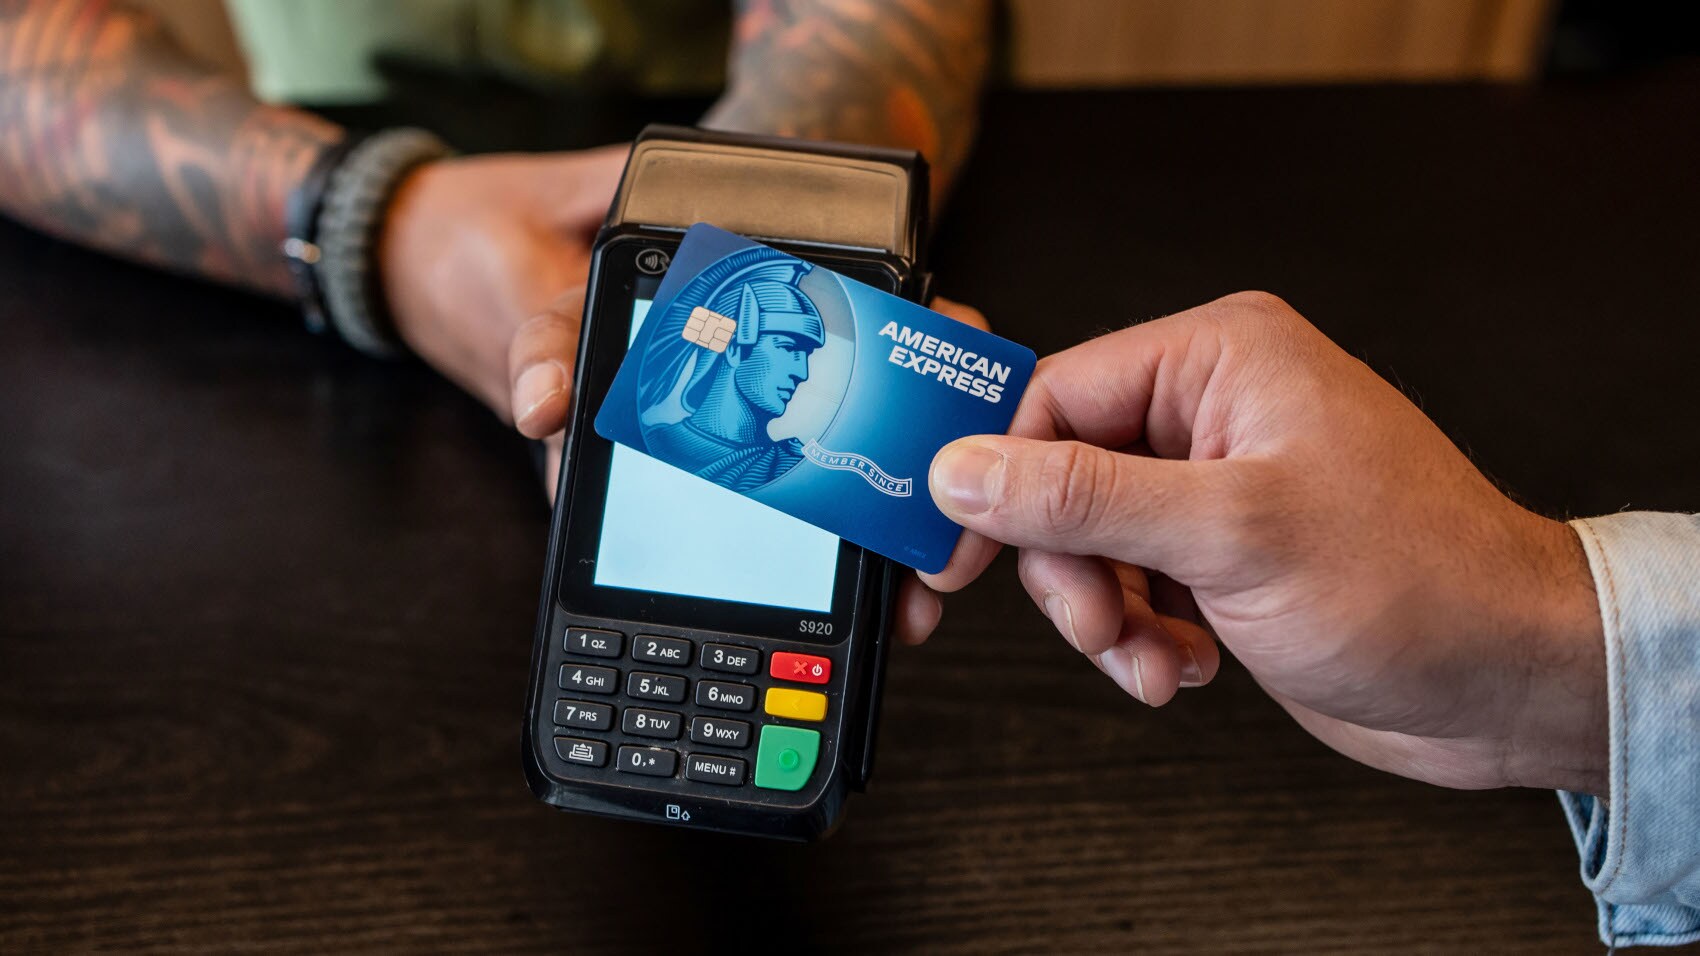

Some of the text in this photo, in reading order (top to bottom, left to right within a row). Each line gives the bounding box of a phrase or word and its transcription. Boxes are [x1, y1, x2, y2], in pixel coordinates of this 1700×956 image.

[878, 320, 1012, 385] AMERICAN
[888, 345, 1005, 404] EXPRESS
[811, 448, 904, 492] MEMBER SINCE
[799, 619, 833, 636] S920
[580, 633, 587, 648] 1
[646, 642, 681, 659] 2 ABC
[713, 649, 747, 667] 3 DEF
[571, 669, 605, 687] 4 GHI
[639, 679, 670, 696] 5 JKL
[708, 686, 744, 705] 6 MNO
[566, 706, 598, 722] 7 PRS
[635, 714, 671, 730] 8 TUV
[703, 722, 740, 740] 9 WXY
[694, 761, 727, 775] MENU
